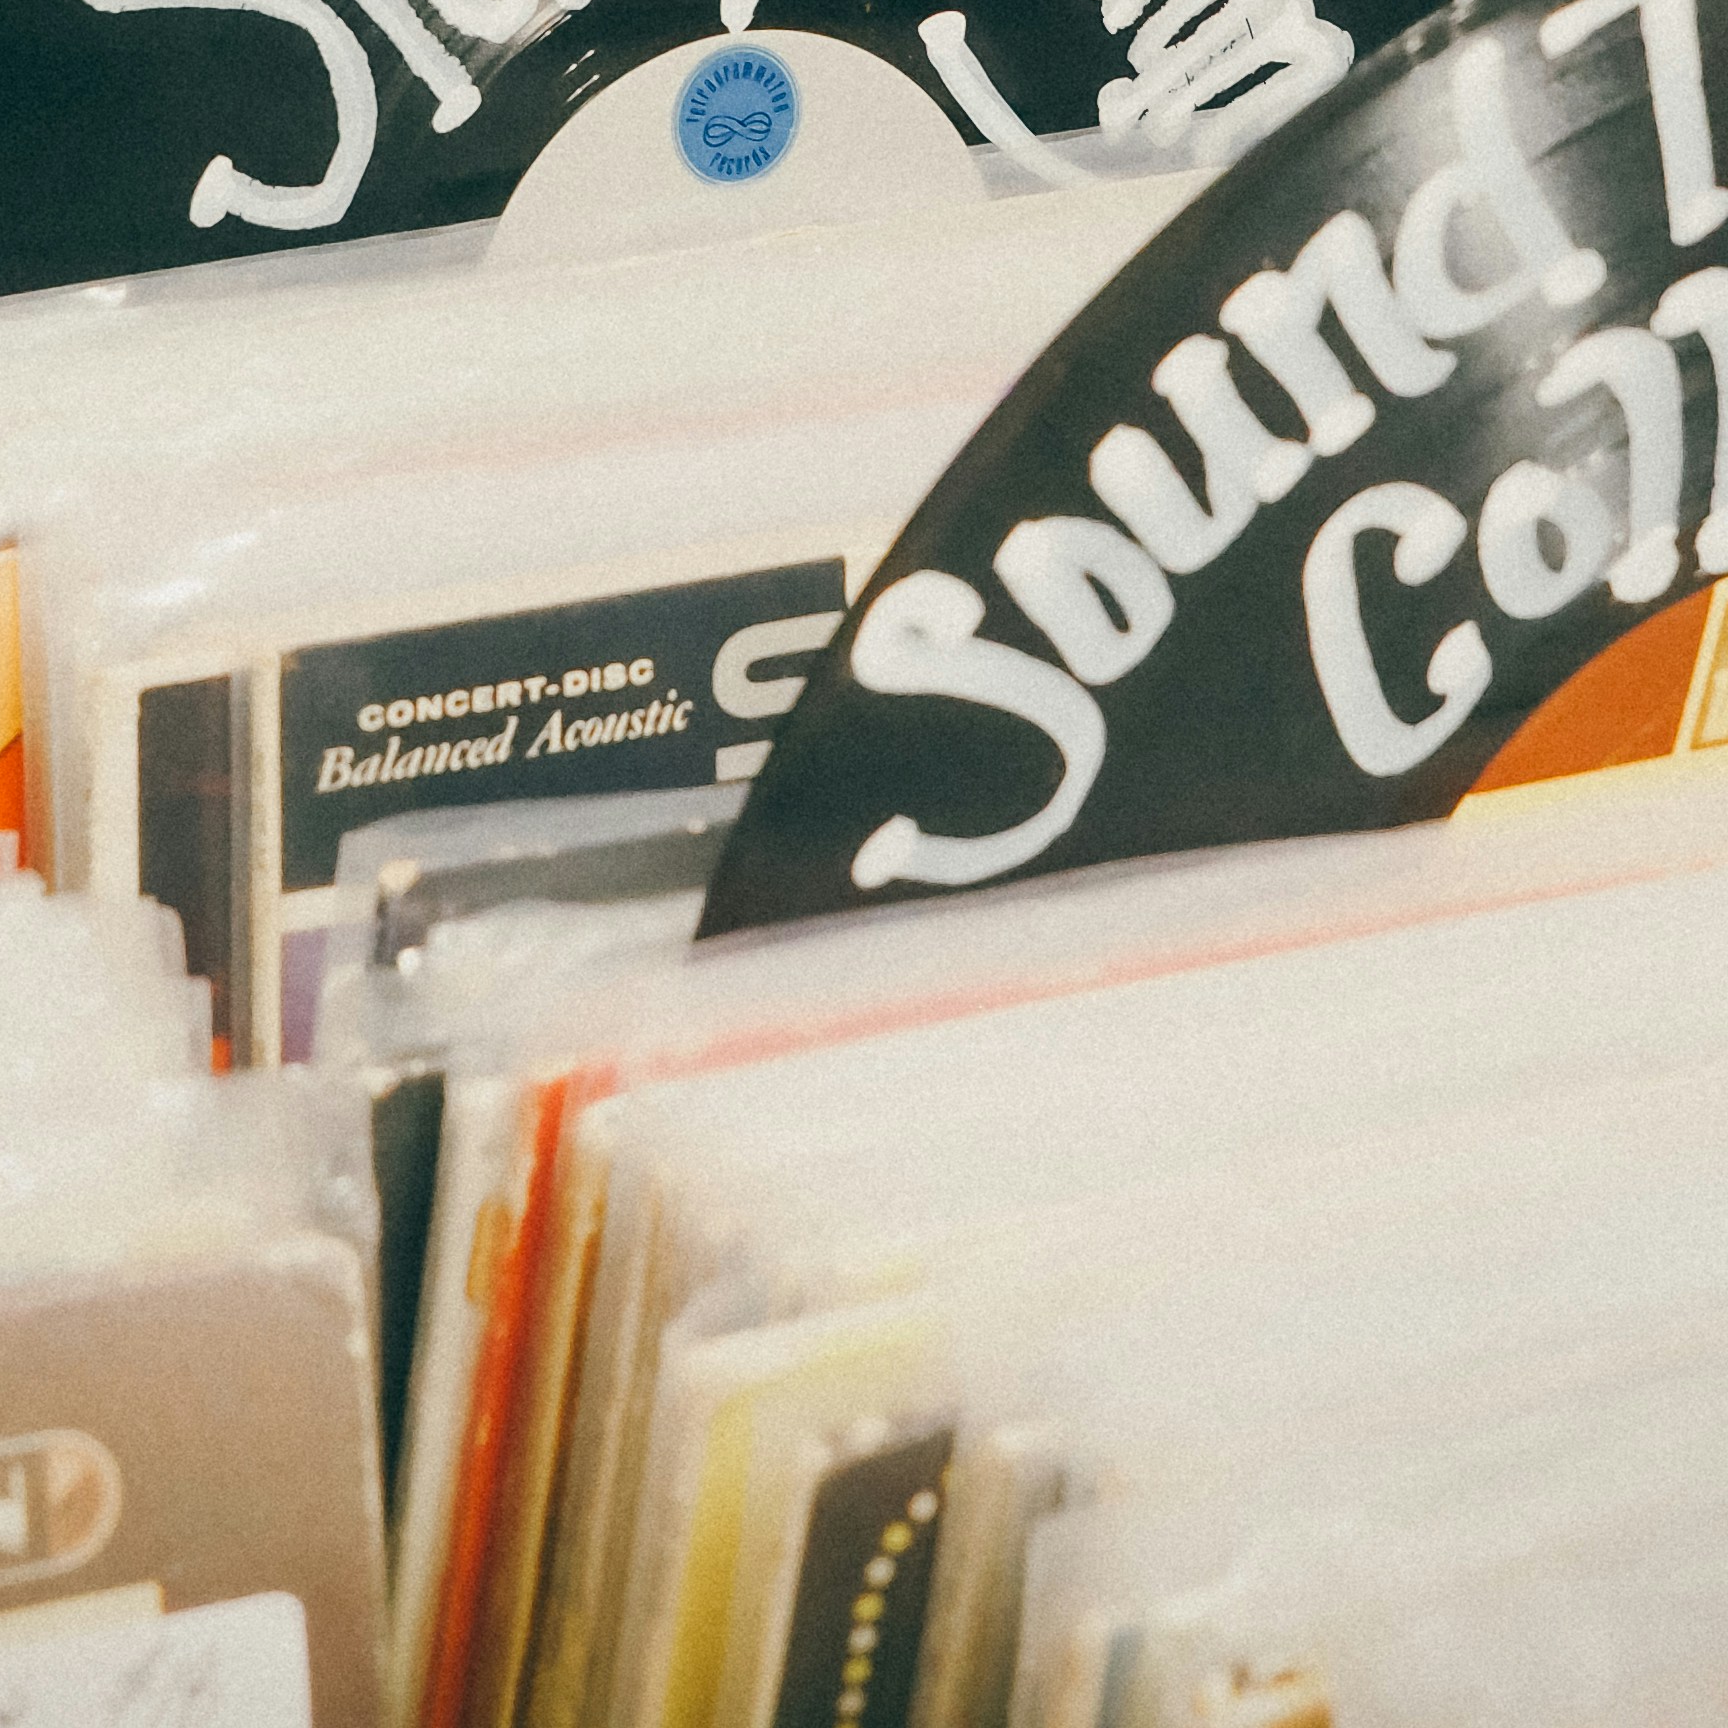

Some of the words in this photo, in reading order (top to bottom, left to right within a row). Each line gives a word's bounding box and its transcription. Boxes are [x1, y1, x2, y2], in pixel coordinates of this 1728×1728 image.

[852, 36, 1608, 890] Sound
[315, 714, 520, 794] Balanced
[525, 687, 695, 759] Acoustic
[357, 656, 656, 733] CONCERT-DISC
